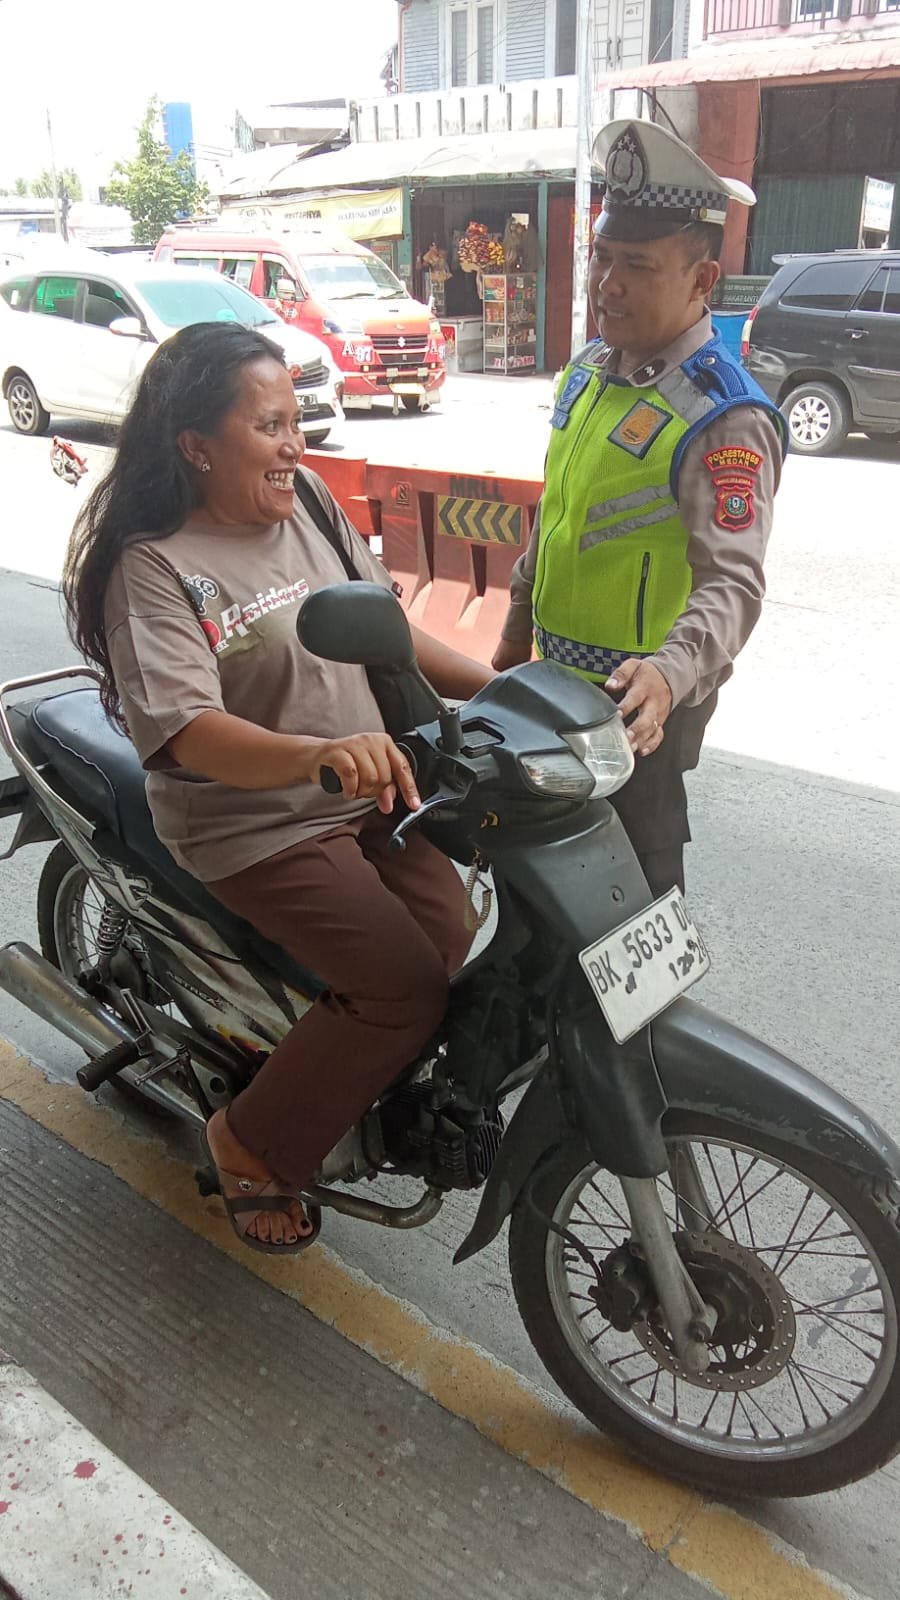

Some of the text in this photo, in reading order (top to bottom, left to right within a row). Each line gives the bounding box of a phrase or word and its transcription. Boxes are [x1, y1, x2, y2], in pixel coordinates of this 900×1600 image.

[707, 449, 760, 465] POLRESTABES
[719, 458, 750, 467] MEDAN
[588, 951, 622, 995] BK
[622, 913, 673, 969] 5633
